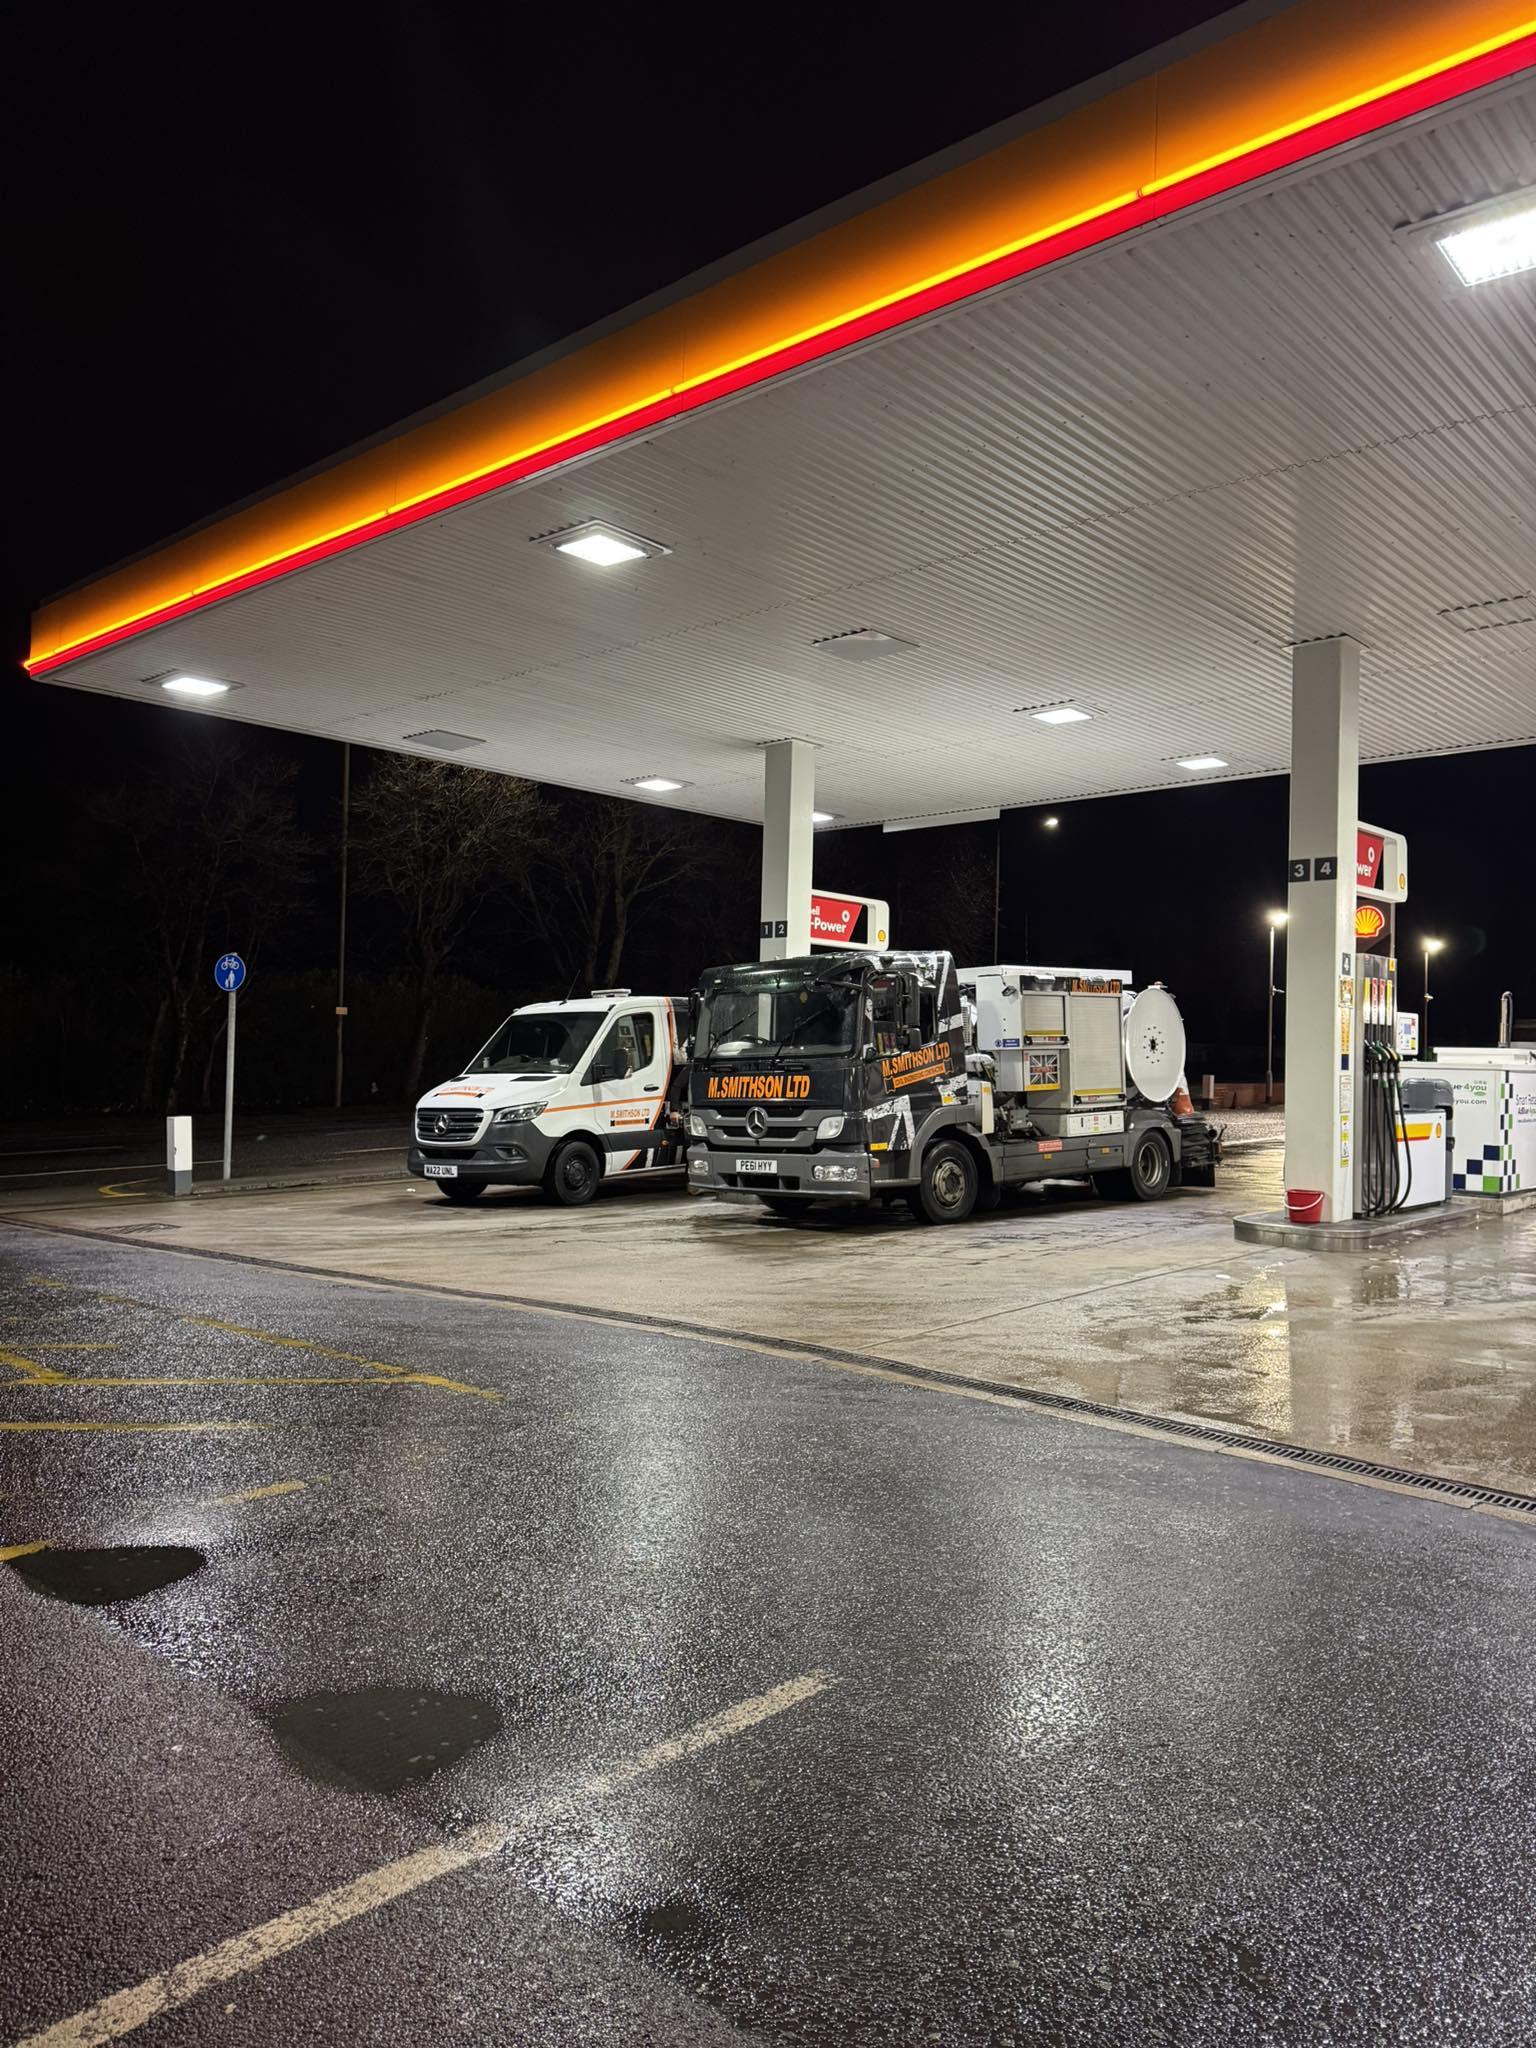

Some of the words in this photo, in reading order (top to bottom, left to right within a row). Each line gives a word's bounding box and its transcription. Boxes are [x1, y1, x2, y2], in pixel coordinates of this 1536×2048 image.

[1294, 863, 1304, 877] 3
[1320, 861, 1332, 875] 4
[764, 925, 769, 935] 1
[778, 924, 785, 934] 2
[1343, 957, 1350, 971] 4
[882, 1045, 934, 1076] M.SMITHSON
[936, 1041, 950, 1060] LTD
[707, 1076, 784, 1098] M.SMITHSON
[786, 1075, 810, 1098] LTD
[1464, 1083, 1487, 1092] 4you
[740, 1160, 757, 1171] PE61
[758, 1161, 772, 1171] HYY
